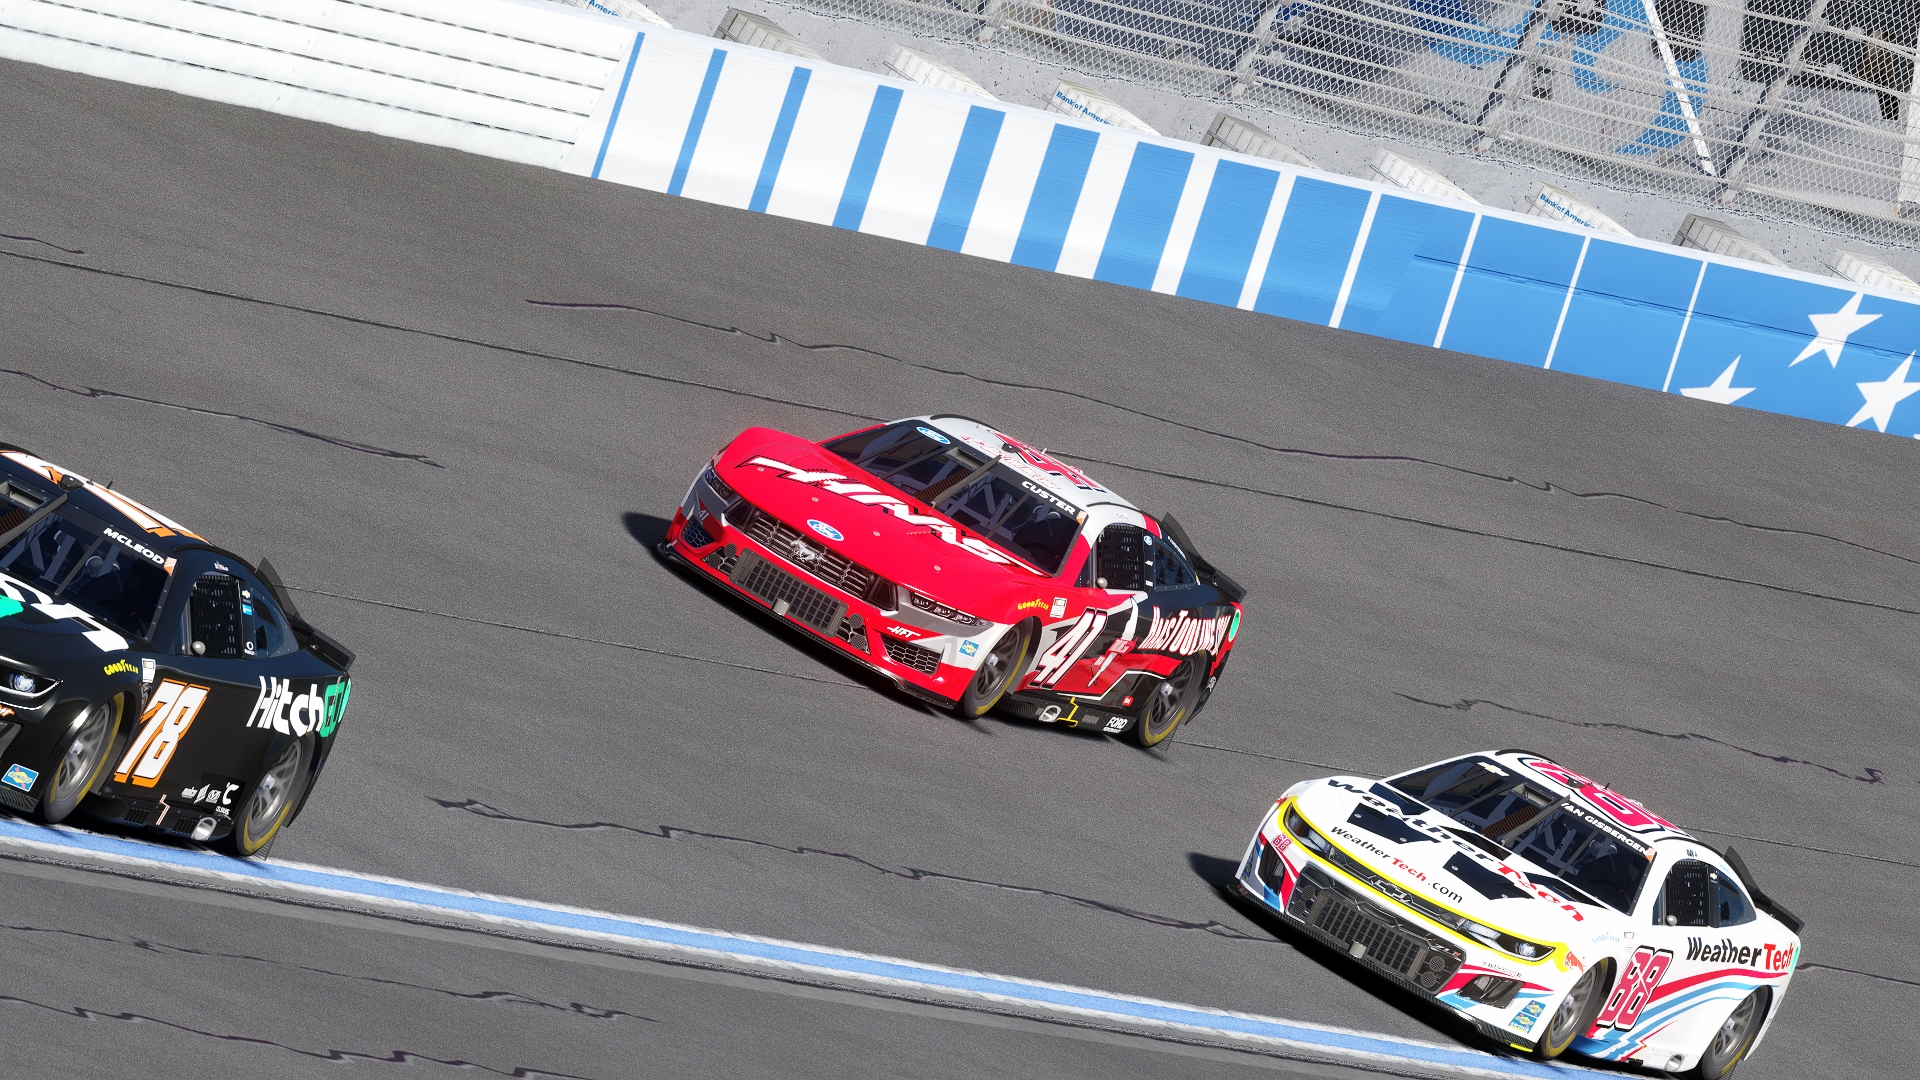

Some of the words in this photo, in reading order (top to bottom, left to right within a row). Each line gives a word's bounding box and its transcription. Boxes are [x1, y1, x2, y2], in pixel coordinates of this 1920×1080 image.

[1056, 91, 1074, 106] Bank
[1074, 102, 1083, 111] of
[1082, 107, 1114, 126] Americ
[1540, 194, 1557, 208] Bank
[1556, 205, 1565, 213] of
[1564, 209, 1595, 229] Americ
[698, 509, 710, 521] 41
[1021, 480, 1076, 515] CUSTER
[103, 527, 165, 565] MCLEOD
[1028, 607, 1108, 690] 41
[104, 659, 139, 676] GOODYEAR
[114, 678, 211, 788] 78
[1106, 716, 1128, 729] FORD
[1271, 832, 1294, 852] 88
[1584, 814, 1648, 855] GISBERGEN
[1596, 945, 1674, 1032] 88
